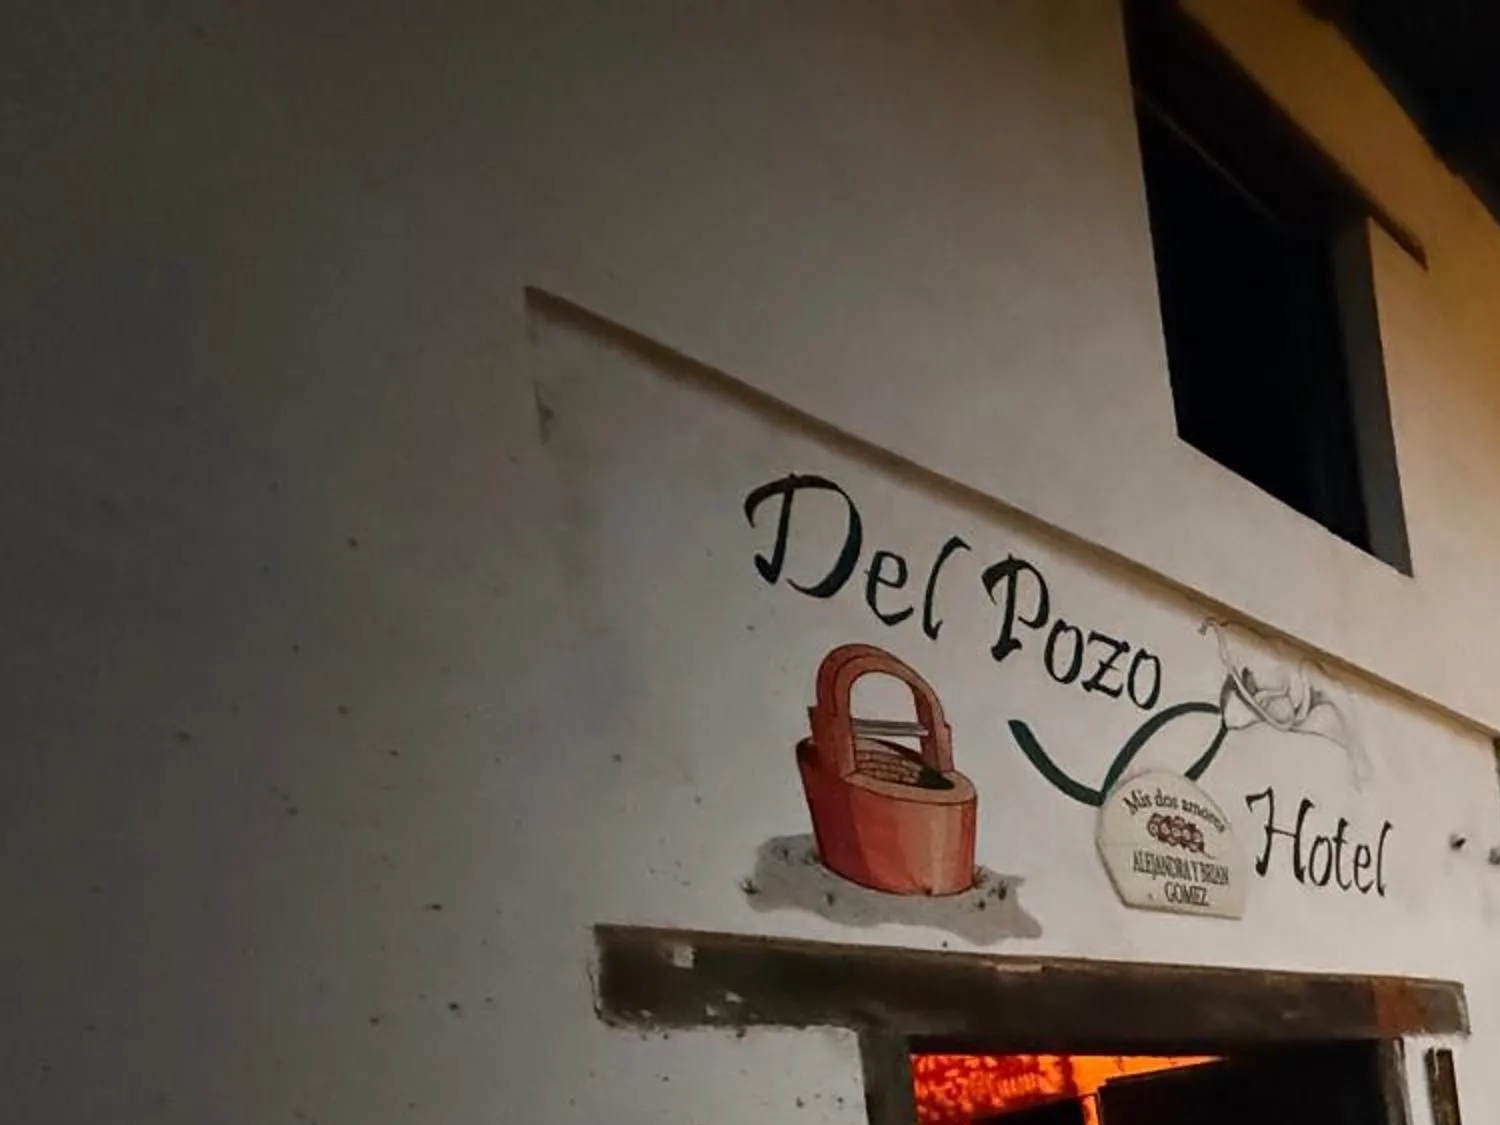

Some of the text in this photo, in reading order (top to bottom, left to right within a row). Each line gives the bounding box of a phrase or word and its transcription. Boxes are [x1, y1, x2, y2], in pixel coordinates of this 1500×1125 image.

[745, 473, 1161, 711] Del Pozo
[1123, 788, 1225, 833] Mis dos amores
[1245, 786, 1393, 896] Hotel
[1133, 849, 1192, 880] ALEJANDRA
[1164, 881, 1210, 906] GOMEZ
